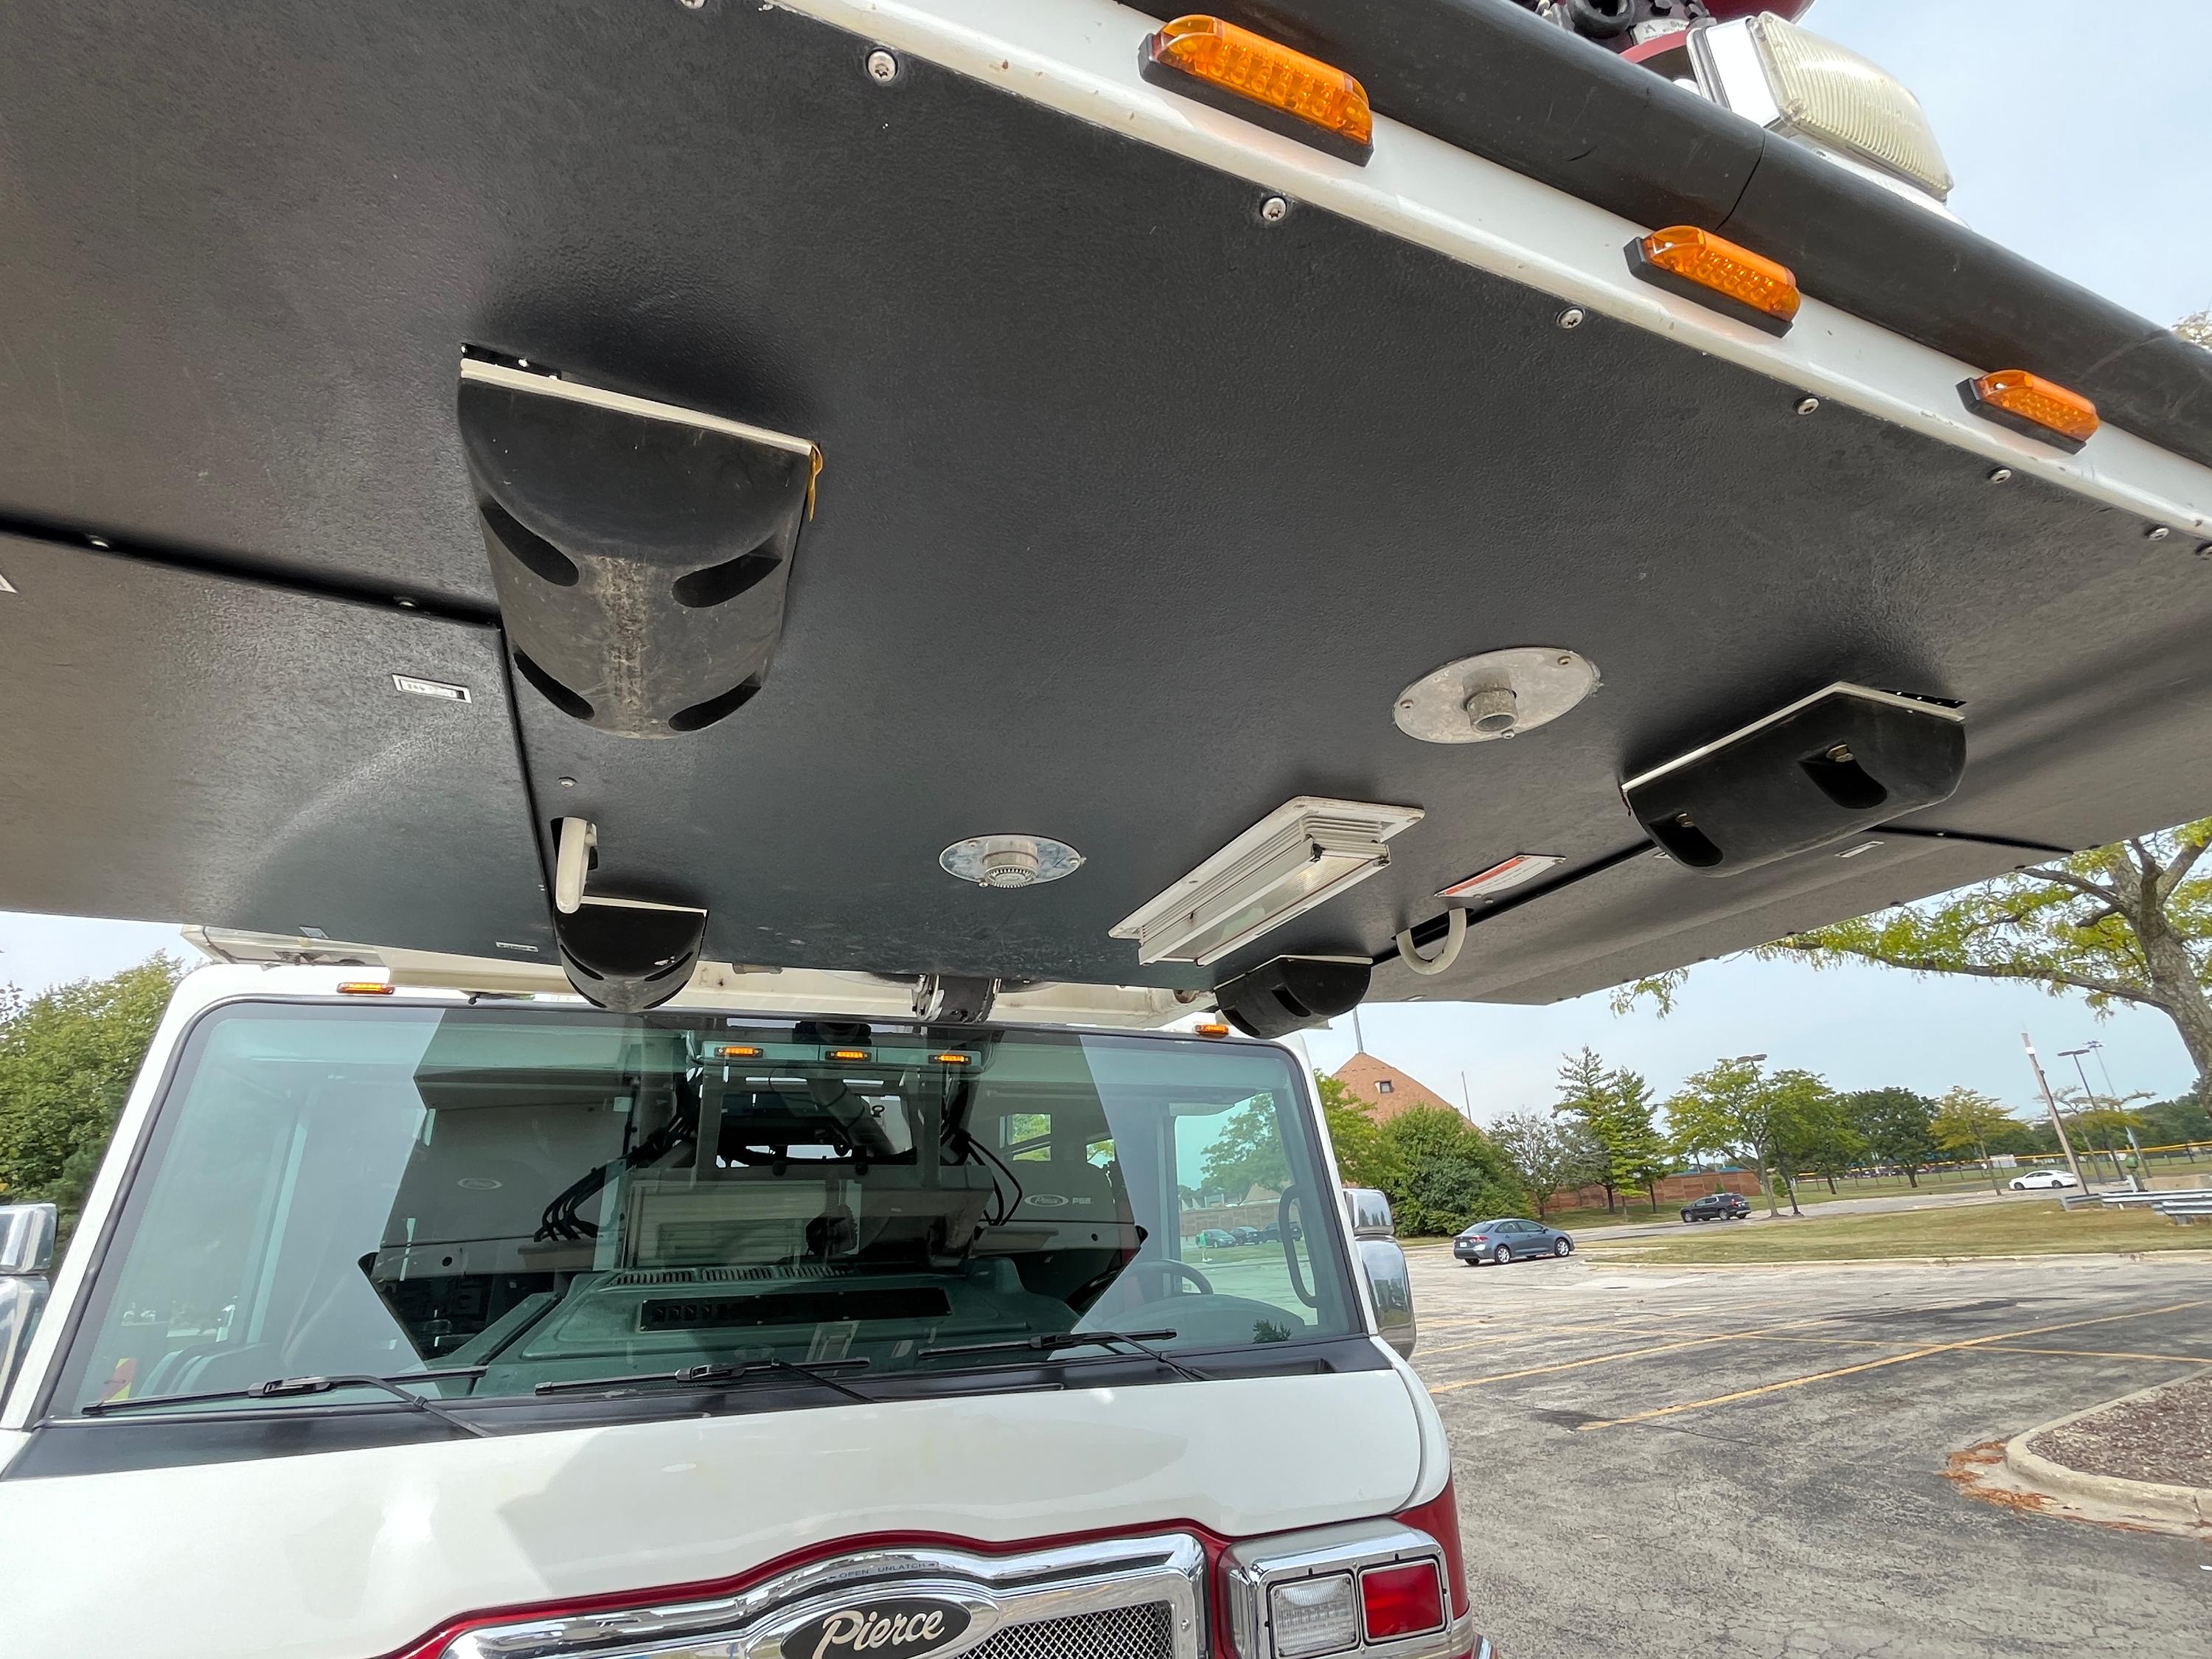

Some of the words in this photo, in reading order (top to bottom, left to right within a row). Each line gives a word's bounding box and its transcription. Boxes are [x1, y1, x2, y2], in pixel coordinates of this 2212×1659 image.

[839, 1568, 869, 1578] OPEN
[877, 1562, 926, 1572] UNLATCH
[812, 1610, 945, 1659] Pierce
